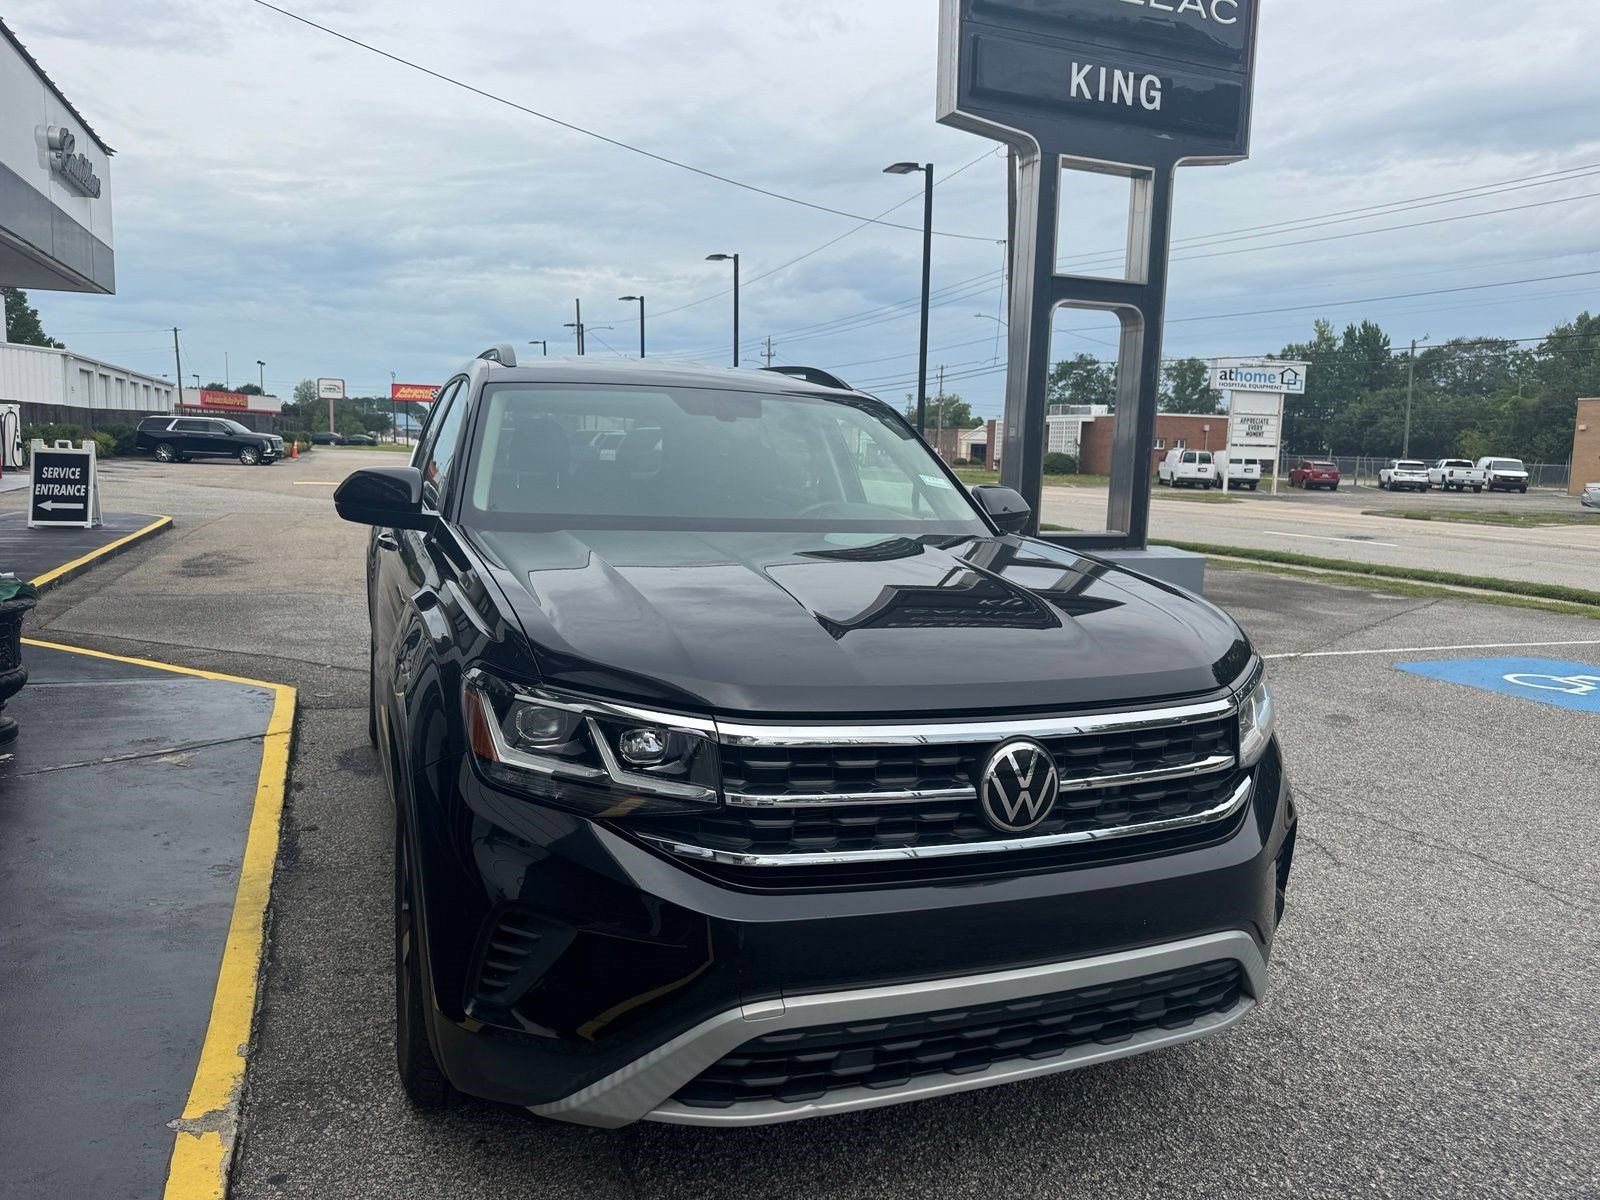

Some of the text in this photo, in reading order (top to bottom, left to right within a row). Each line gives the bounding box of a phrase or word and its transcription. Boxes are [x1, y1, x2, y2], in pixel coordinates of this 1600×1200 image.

[1070, 62, 1162, 111] KING
[1219, 367, 1276, 383] athome
[1249, 383, 1282, 391] EQUIPMENT
[1240, 417, 1269, 425] APPRECIATE
[41, 466, 81, 479] SERVICE
[35, 484, 87, 496] ENTRANCE
